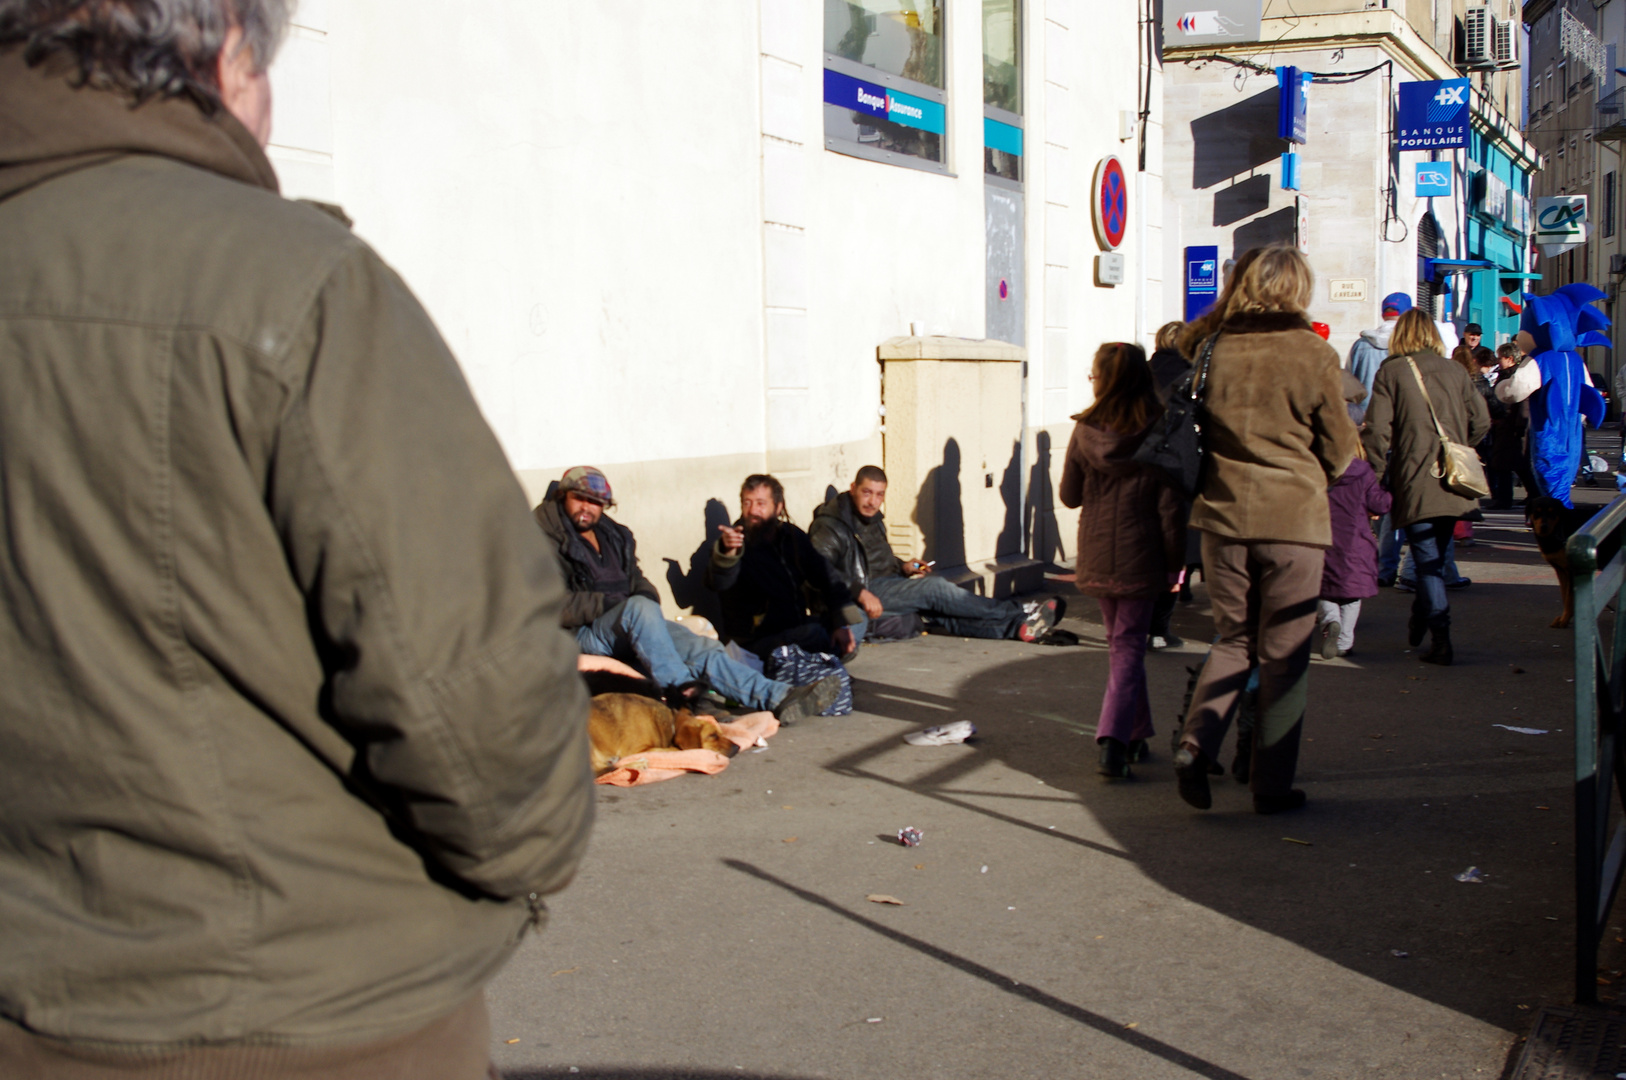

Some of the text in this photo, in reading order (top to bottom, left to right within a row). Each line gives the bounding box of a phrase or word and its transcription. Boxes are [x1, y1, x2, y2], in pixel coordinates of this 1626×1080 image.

[857, 87, 922, 119] Banque Assurance
[1401, 126, 1463, 137] BANQUE
[1401, 136, 1463, 147] POPULAIRE
